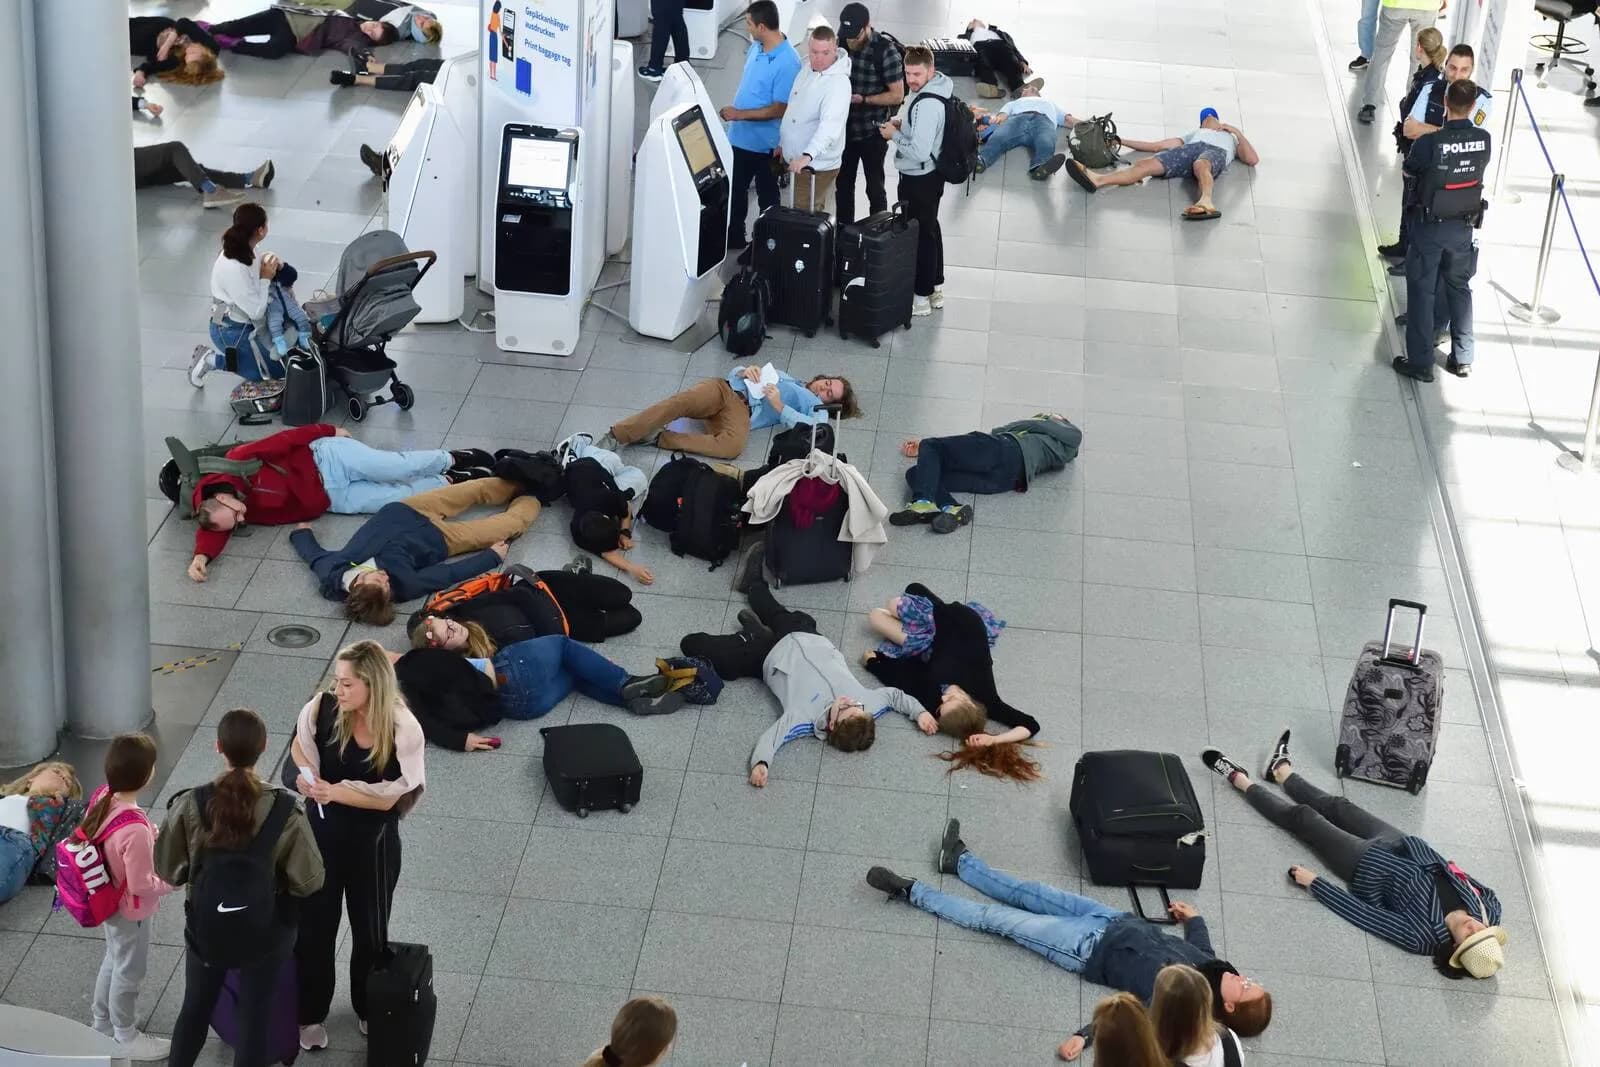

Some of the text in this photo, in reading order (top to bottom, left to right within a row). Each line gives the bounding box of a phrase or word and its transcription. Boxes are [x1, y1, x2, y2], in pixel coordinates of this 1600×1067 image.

[525, 7, 569, 31] Gepäckanhänger
[525, 22, 555, 38] ausdrucken
[525, 38, 571, 67] Print baggage tag
[1442, 141, 1485, 154] POLIZEI
